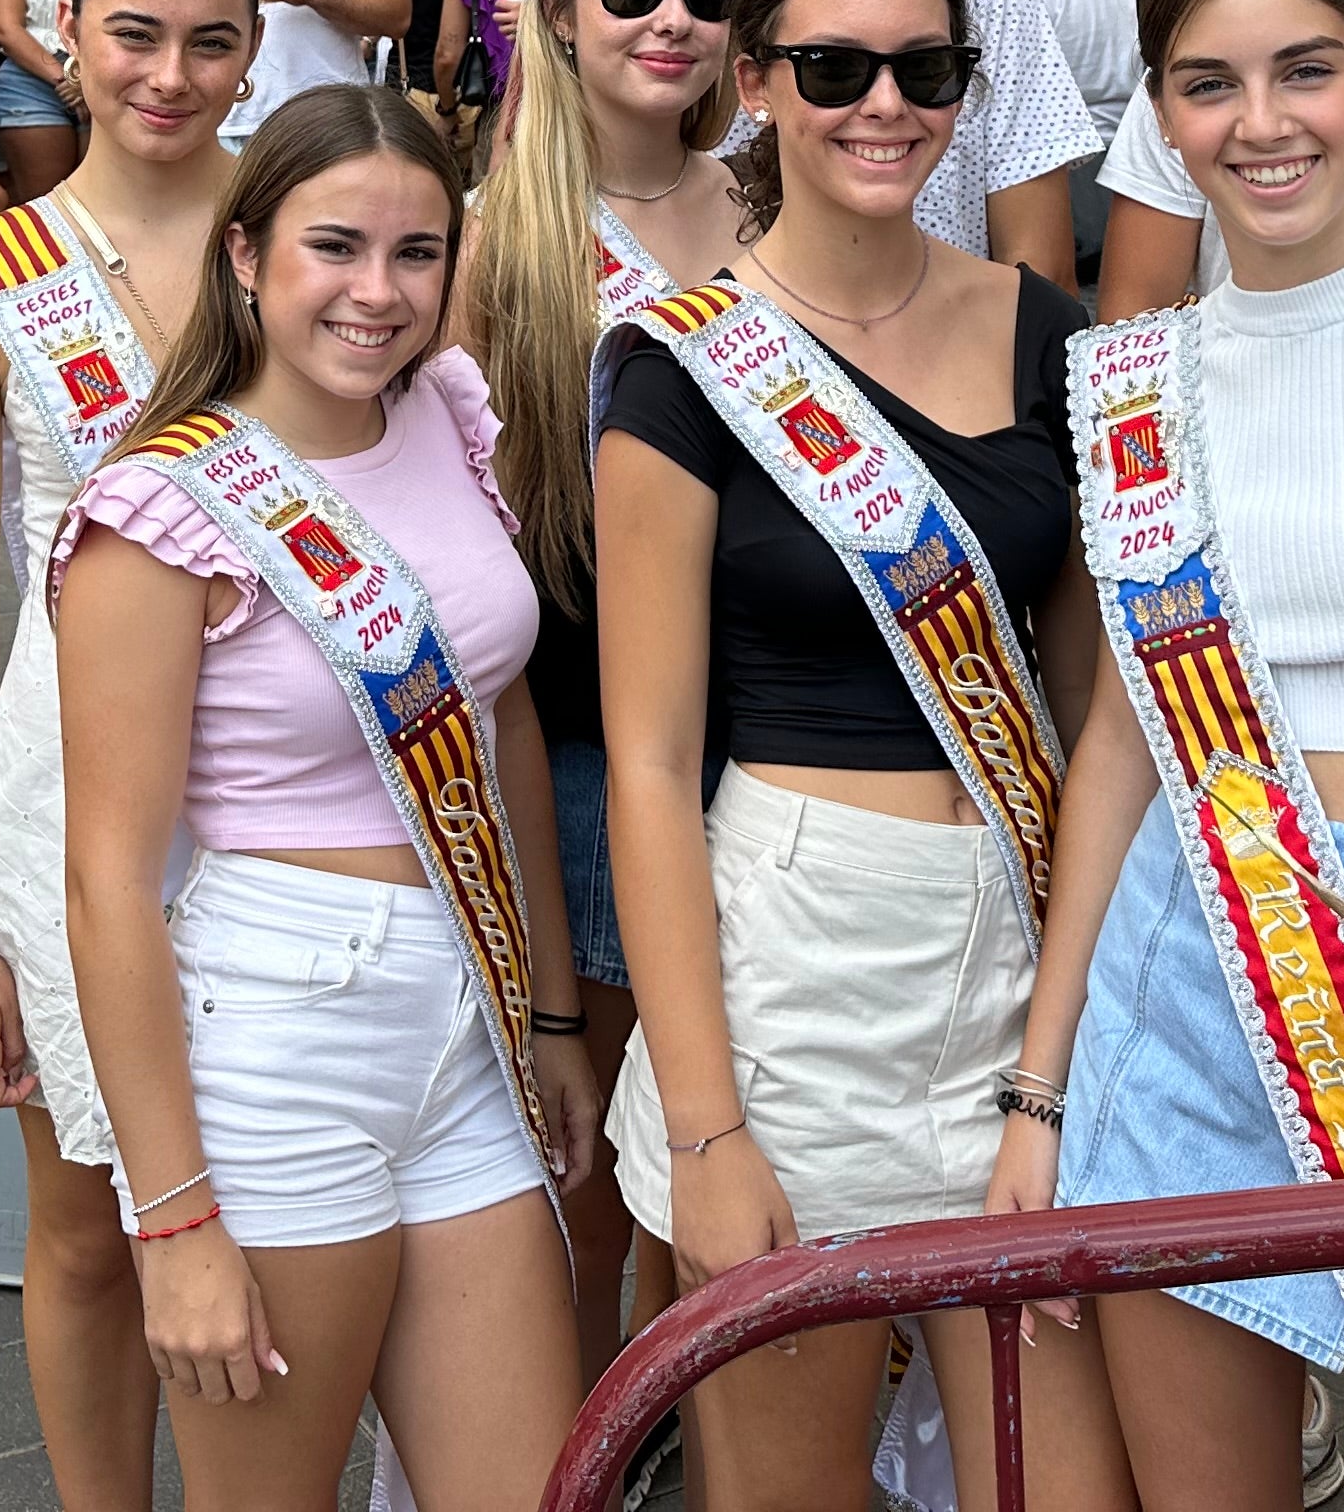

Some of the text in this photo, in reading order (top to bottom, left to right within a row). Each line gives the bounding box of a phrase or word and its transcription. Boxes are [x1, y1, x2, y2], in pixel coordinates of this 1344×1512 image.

[17, 279, 80, 317] FESTES
[21, 299, 93, 337] D'AGOST
[707, 315, 767, 367] FESTES
[721, 336, 789, 389] D'AGOST
[1096, 326, 1168, 363] FESTES
[1089, 350, 1170, 387] D'AGOST
[205, 445, 258, 484] FESTES
[223, 464, 281, 506] D'AGOST
[820, 446, 888, 502] LA NUCIA
[854, 485, 904, 532] 2024
[1100, 499, 1123, 522] LA
[1120, 521, 1175, 561] 2024
[350, 564, 388, 615] NUCIA
[358, 604, 403, 652] 2024
[938, 653, 1043, 849] Dama
[429, 776, 511, 975] Dama
